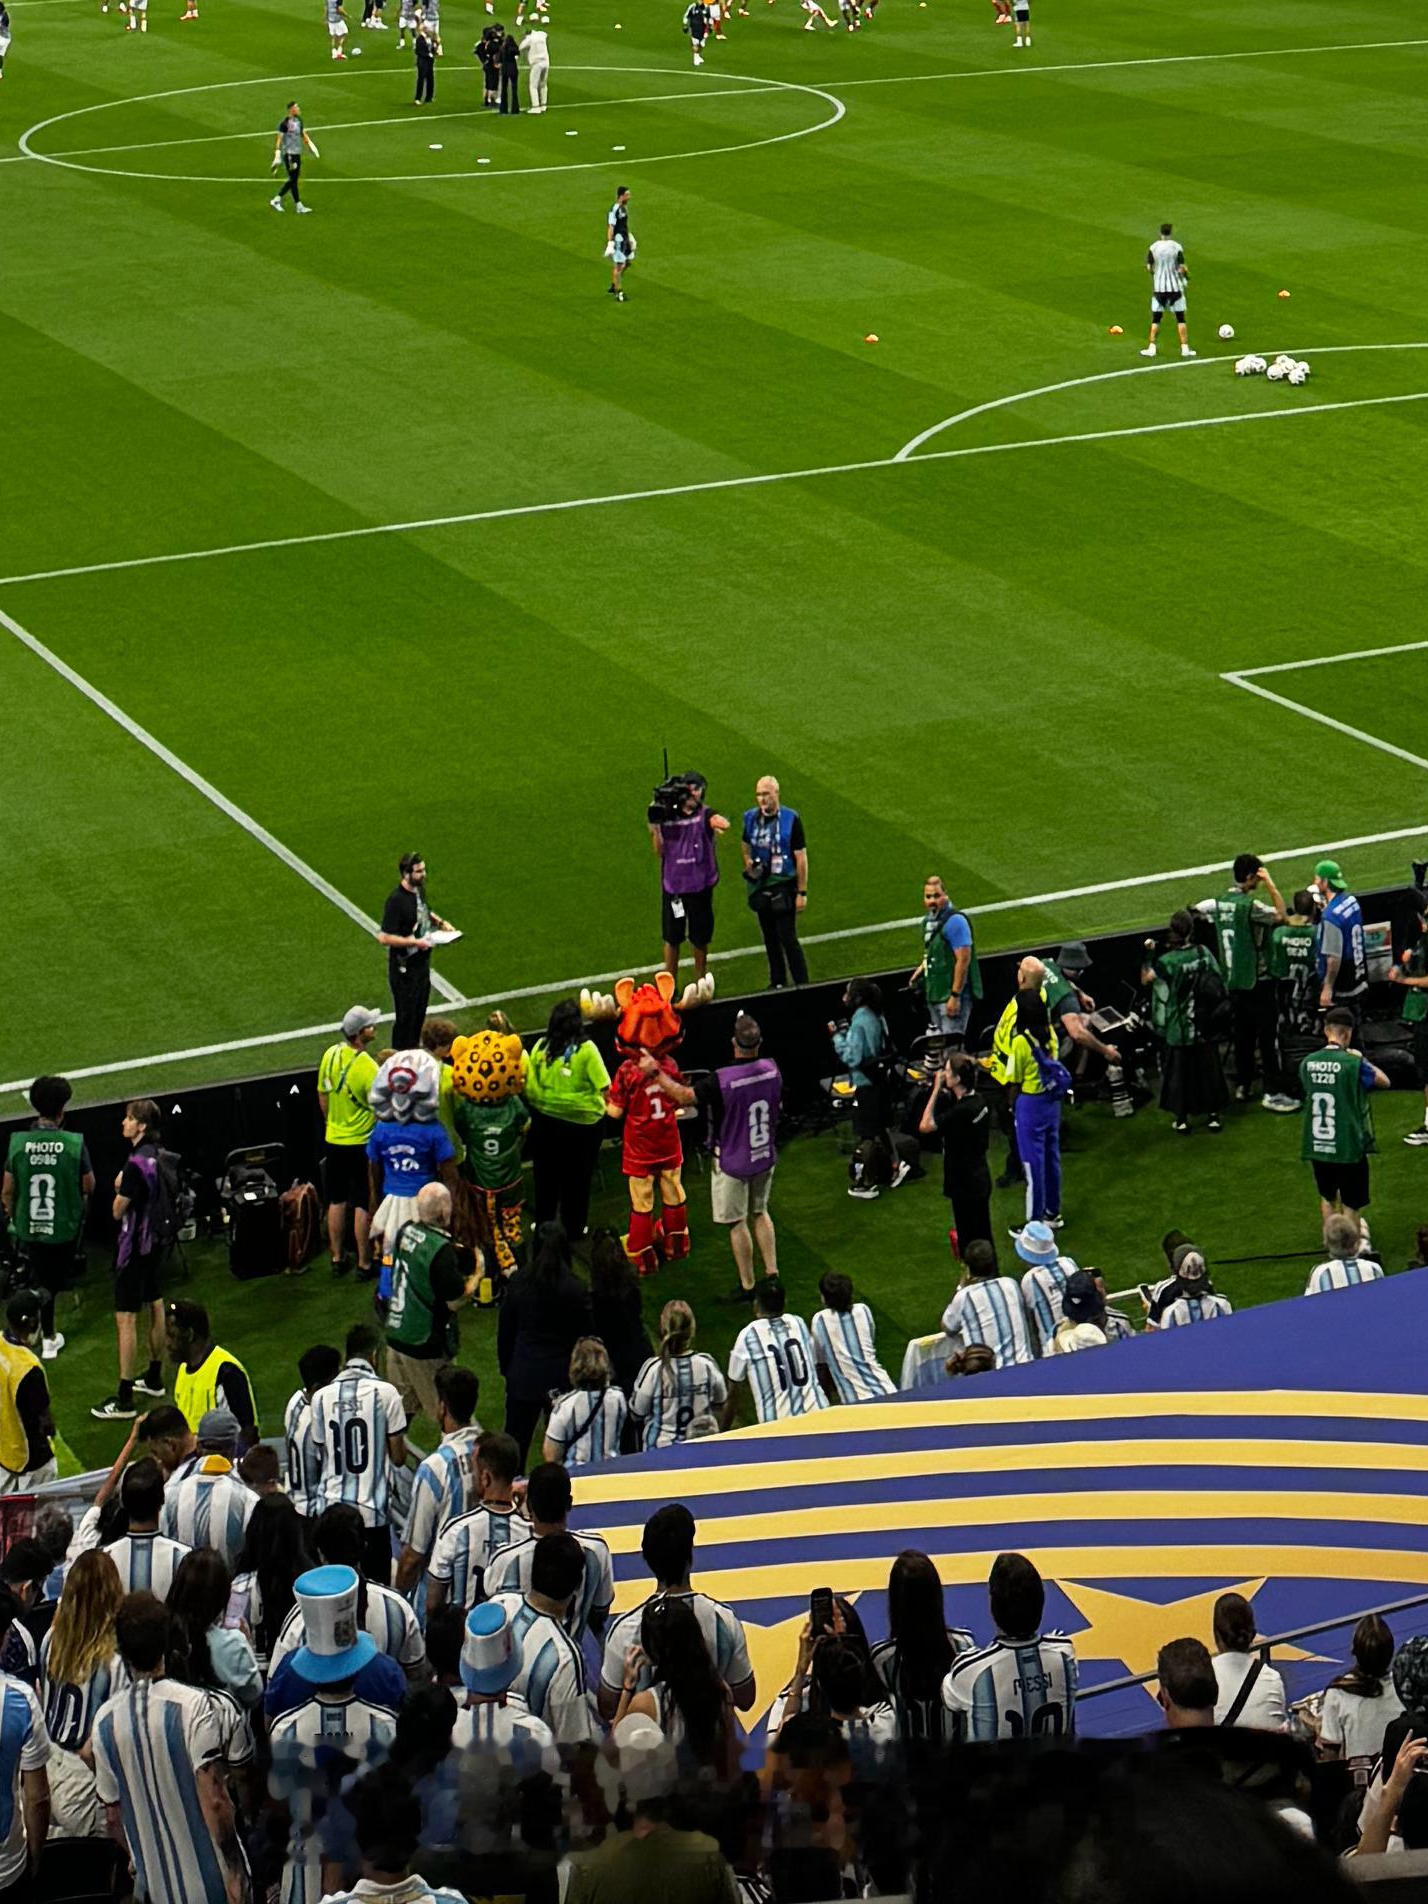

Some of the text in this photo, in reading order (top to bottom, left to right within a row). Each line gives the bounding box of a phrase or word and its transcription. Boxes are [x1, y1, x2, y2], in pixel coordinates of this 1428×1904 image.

[1307, 1060, 1341, 1073] PHOTO
[24, 1141, 64, 1154] PHOTO
[483, 1139, 500, 1156] 9
[767, 1339, 808, 1392] 10
[328, 1417, 368, 1477] 10
[1012, 1671, 1053, 1696] MESSI
